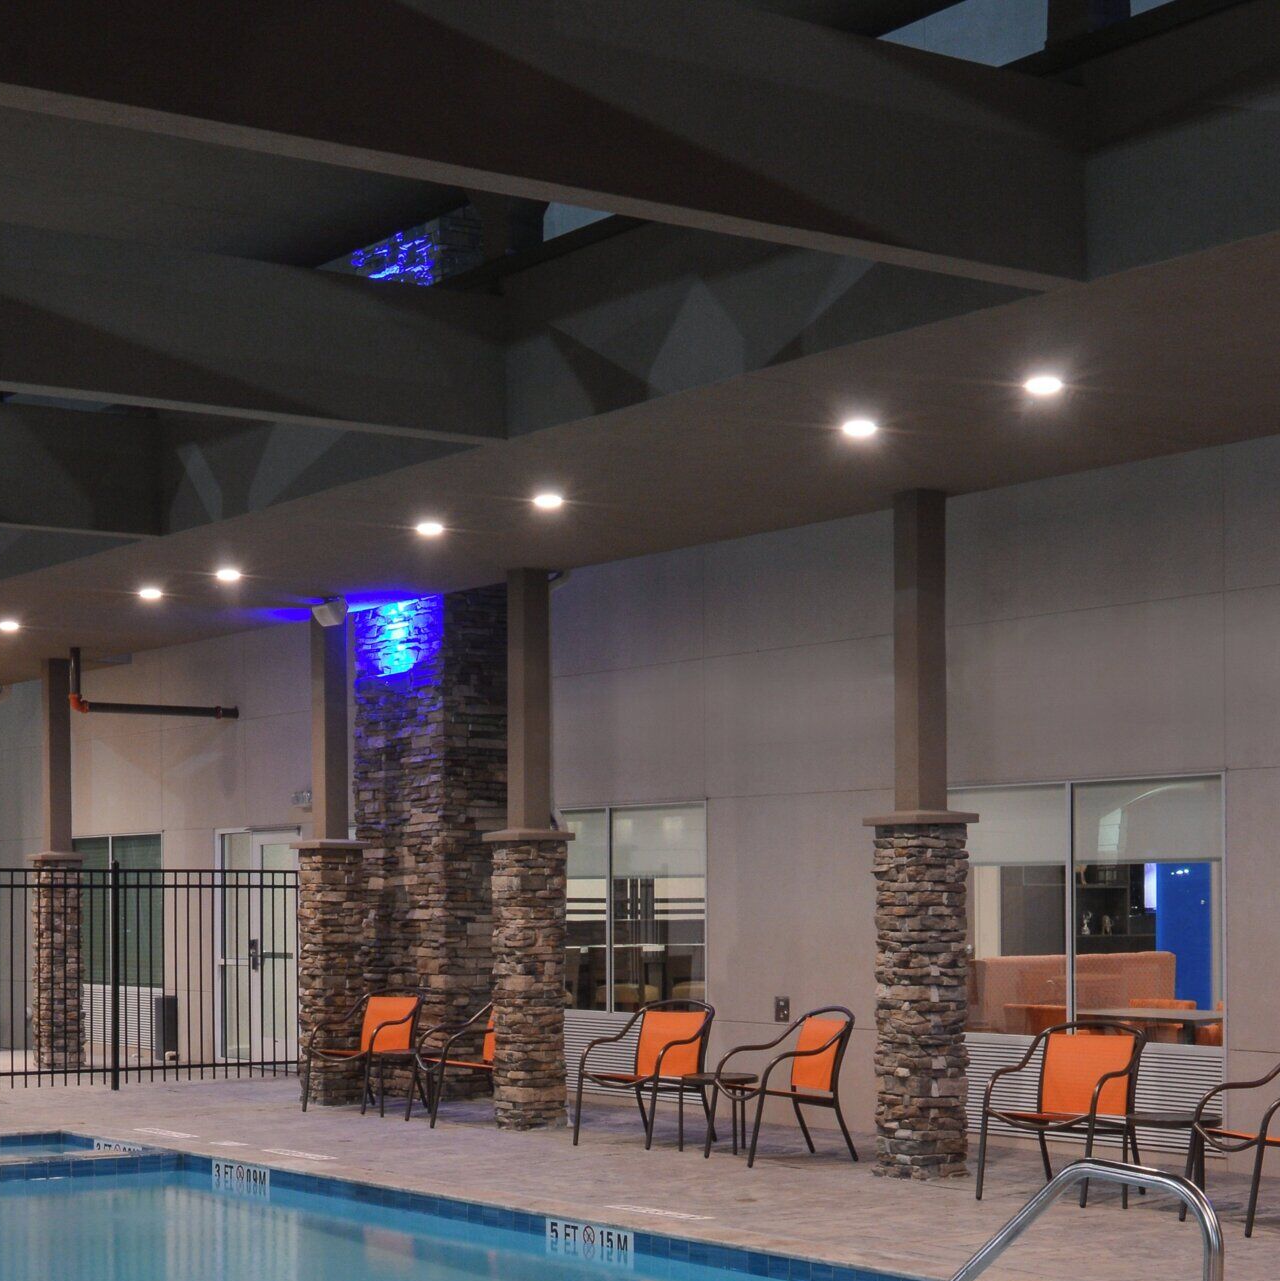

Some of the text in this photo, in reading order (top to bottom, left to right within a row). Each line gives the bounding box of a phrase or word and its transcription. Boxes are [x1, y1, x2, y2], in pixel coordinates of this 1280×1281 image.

[224, 1164, 234, 1180] FT
[550, 1221, 559, 1239] 5
[564, 1223, 579, 1242] FT
